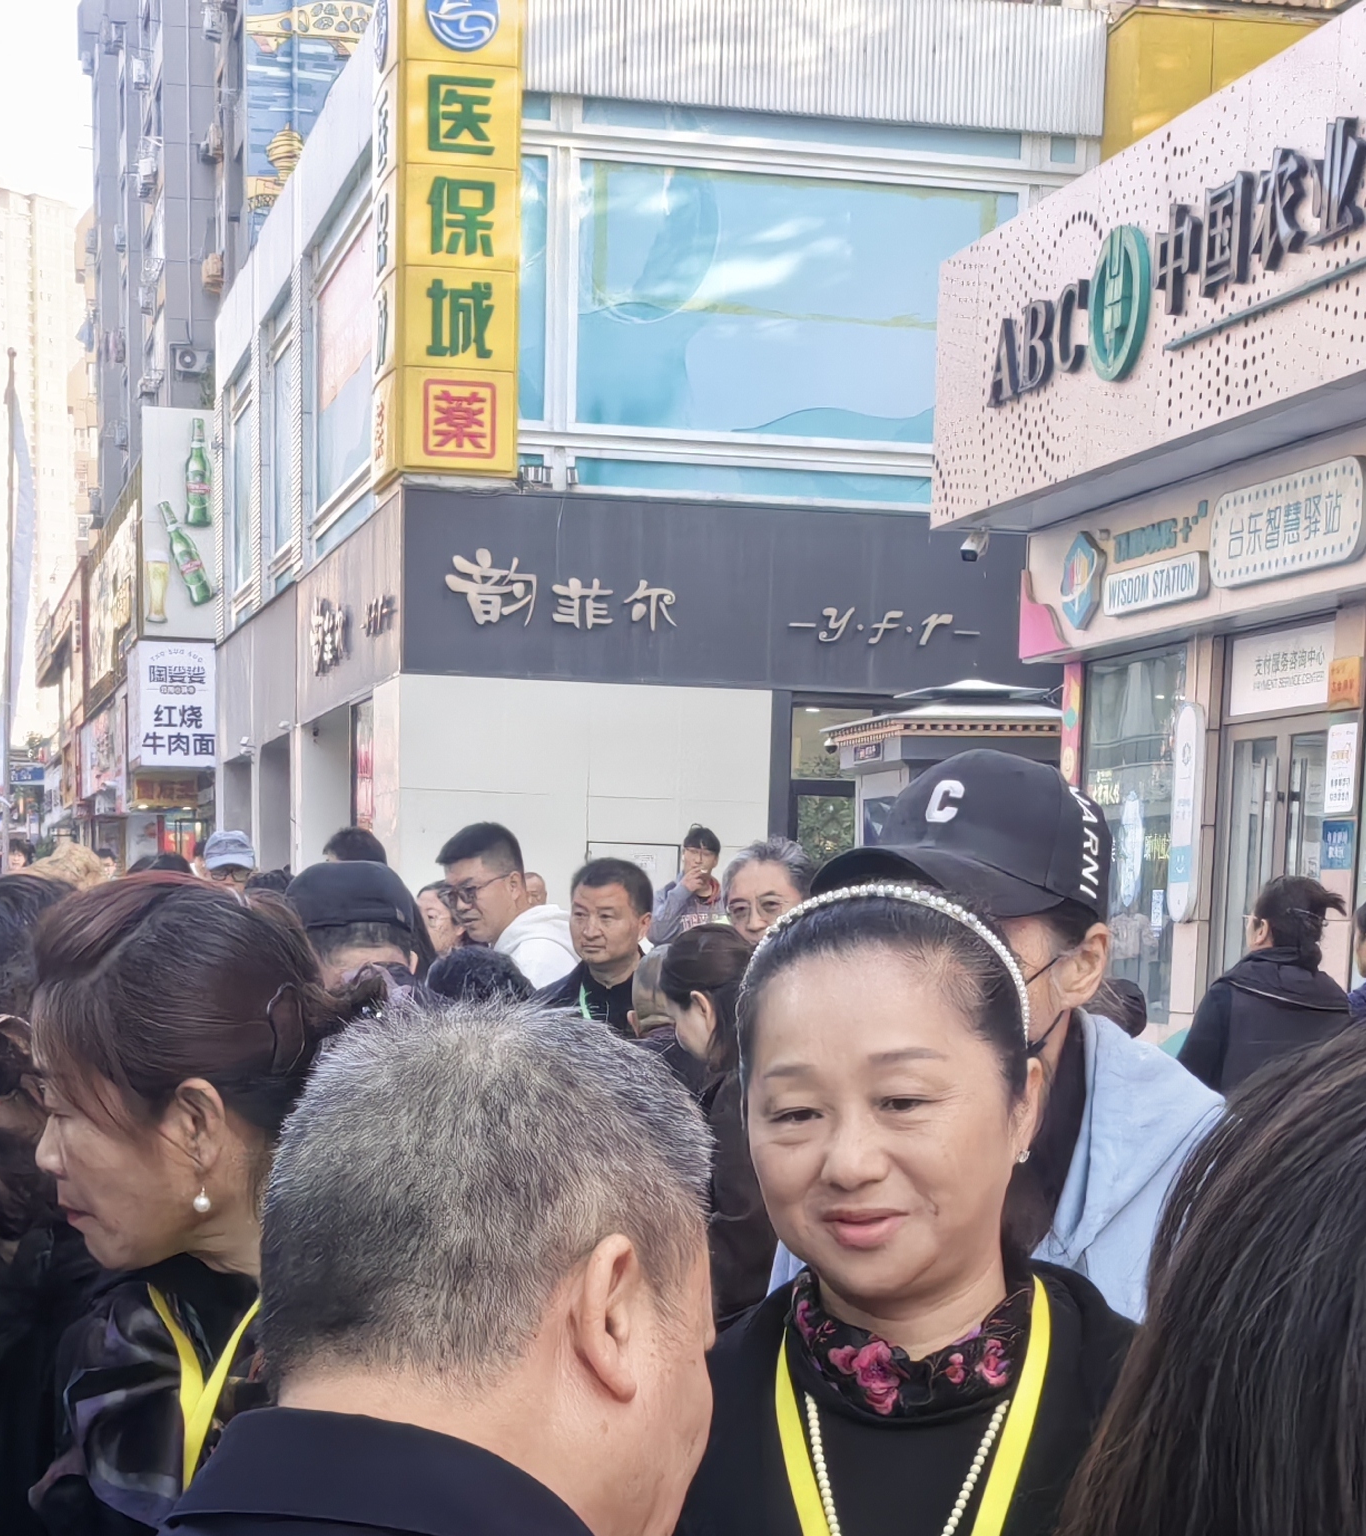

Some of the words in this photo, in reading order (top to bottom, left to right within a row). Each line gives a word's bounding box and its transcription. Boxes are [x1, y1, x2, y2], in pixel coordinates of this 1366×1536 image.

[426, 74, 496, 359] 医保城
[987, 279, 1089, 408] ABC
[1227, 488, 1344, 560] 台东智慧驿站
[444, 548, 677, 631] 韵菲尔
[1109, 572, 1149, 609] WISDOM
[1153, 561, 1195, 598] STATION
[1254, 647, 1325, 676] 支付服务咨询中心
[154, 705, 203, 729] 红烧
[142, 732, 215, 756] 牛肉面
[925, 780, 965, 823] C
